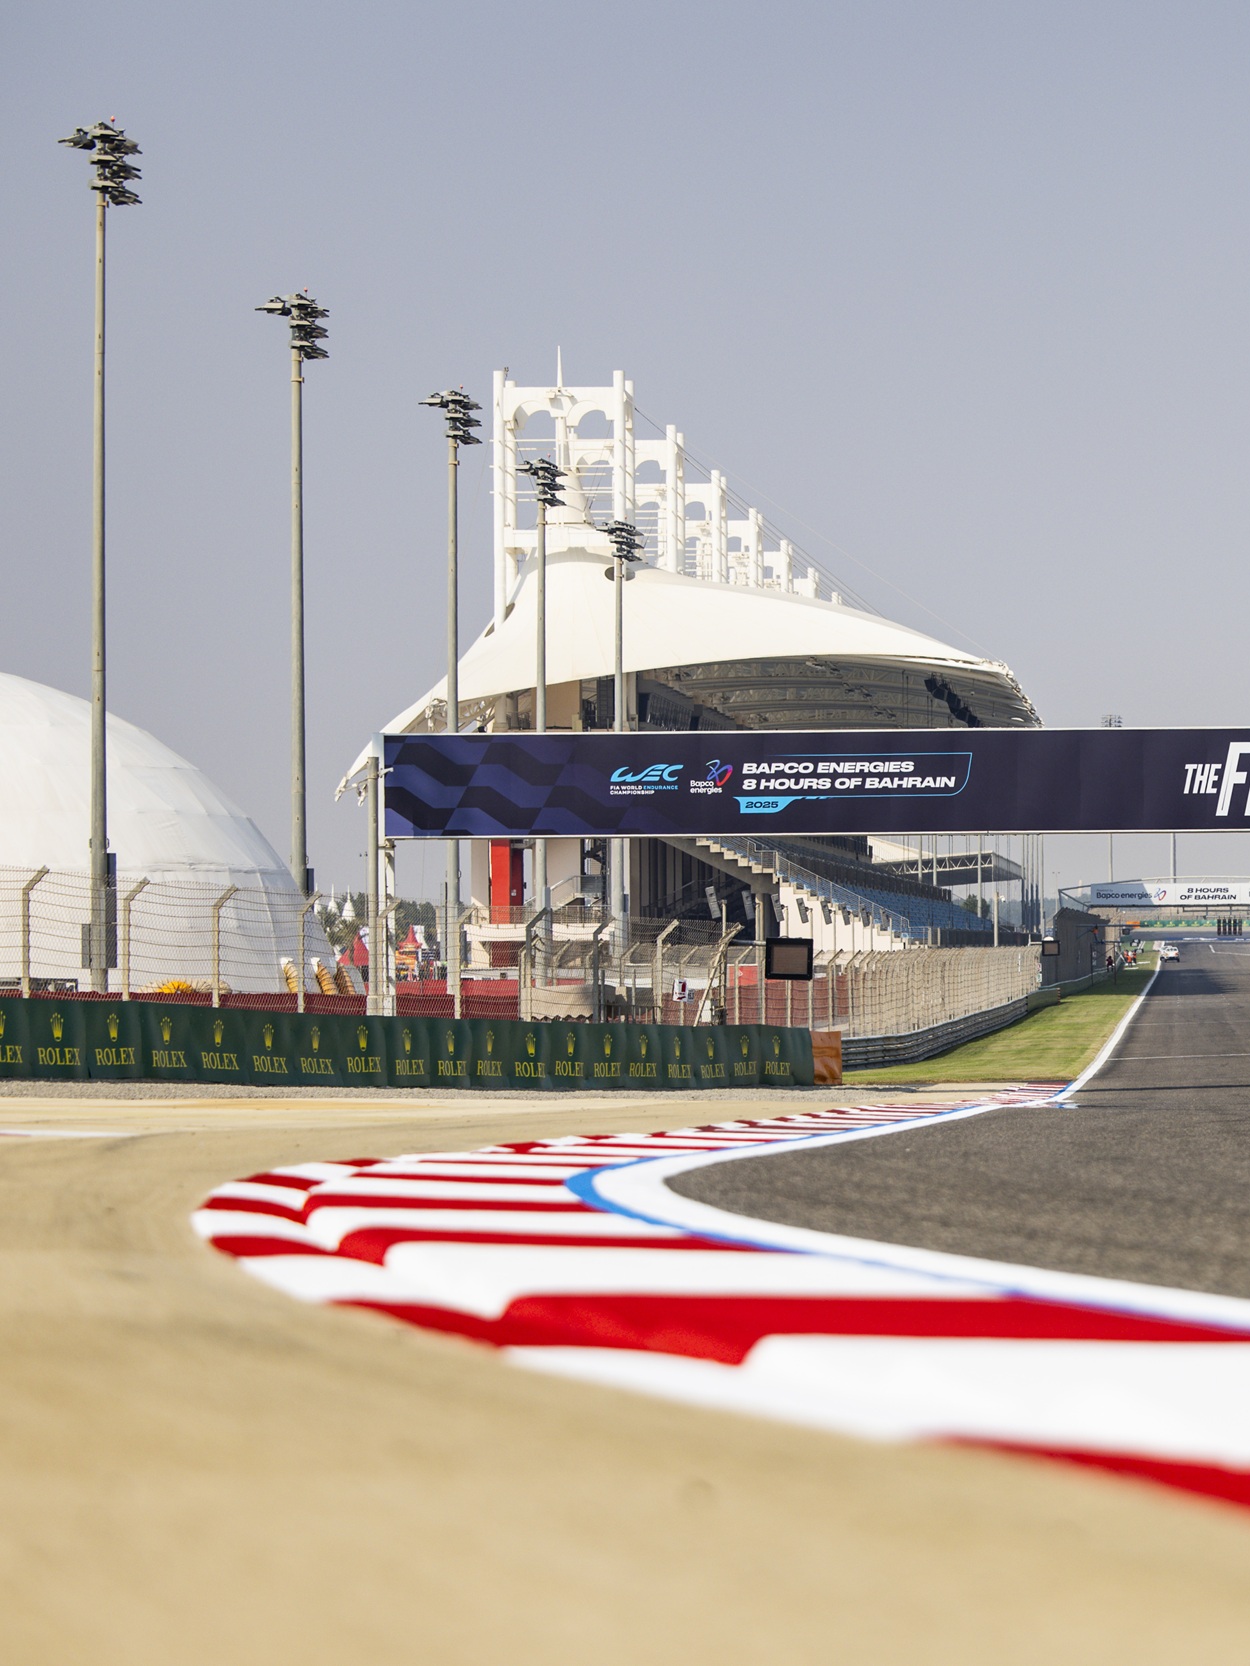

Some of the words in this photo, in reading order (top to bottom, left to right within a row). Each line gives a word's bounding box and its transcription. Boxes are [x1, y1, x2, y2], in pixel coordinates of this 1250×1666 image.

[610, 763, 684, 782] WEC
[742, 762, 814, 774] BAPCO
[816, 761, 915, 773] ENERGIES
[690, 780, 714, 788] Bapco
[742, 778, 757, 790] 8
[759, 778, 832, 790] HOURS
[834, 777, 863, 789] OF
[865, 776, 956, 789] BAHRAIN
[1183, 763, 1222, 794] THE
[690, 787, 722, 795] energies
[745, 801, 779, 809] 2025
[1096, 891, 1120, 899] Bapco
[1120, 891, 1152, 900] energies
[0, 1044, 23, 1063] LEX
[37, 1047, 81, 1065] ROLEX
[95, 1048, 135, 1065] ROLEX
[152, 1050, 187, 1067] ROLEX
[201, 1051, 239, 1070] ROLEX
[253, 1055, 288, 1073] ROLEX
[301, 1057, 334, 1074] ROLEX
[347, 1056, 381, 1073] ROLEX
[395, 1059, 425, 1075] ROLEX
[477, 1060, 502, 1077] ROLEX
[629, 1062, 657, 1077] ROLEX
[668, 1063, 692, 1079] ROLEX
[700, 1063, 725, 1079] ROLEX
[734, 1061, 757, 1077] ROLEX
[764, 1061, 790, 1076] ROLEX
